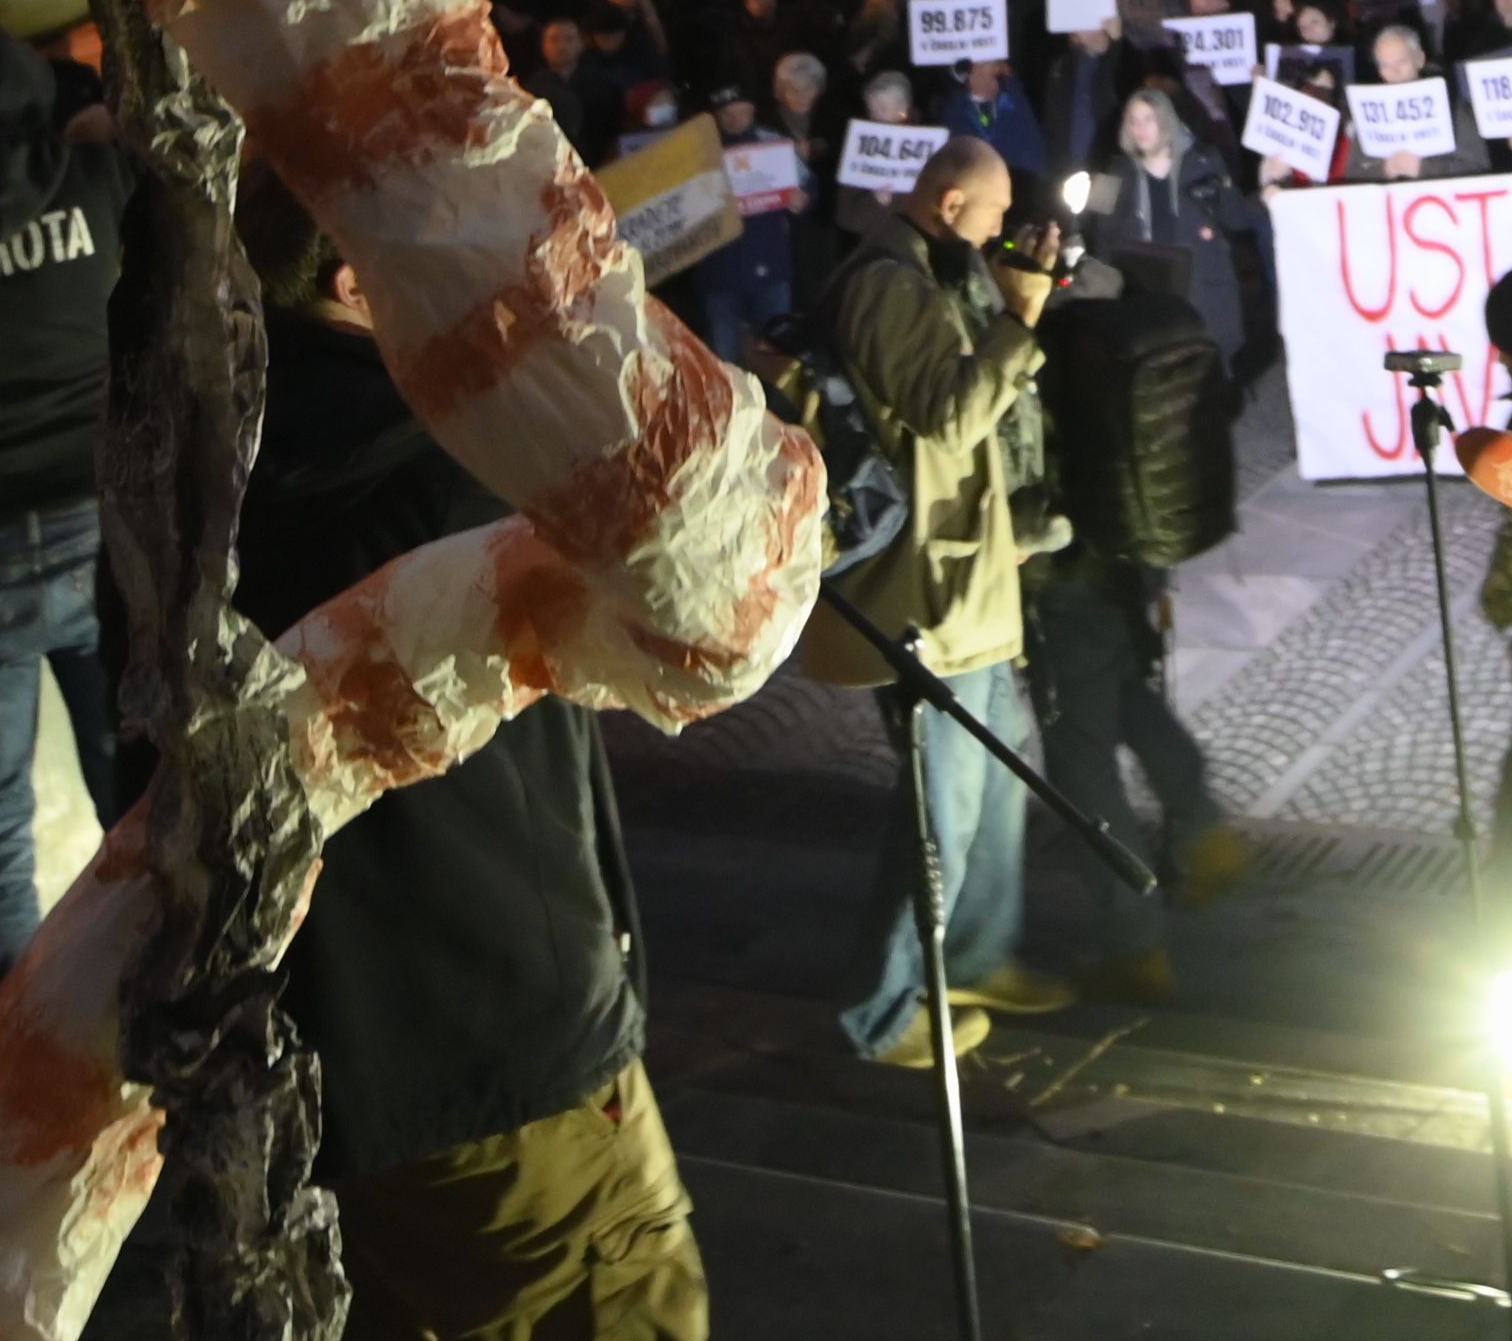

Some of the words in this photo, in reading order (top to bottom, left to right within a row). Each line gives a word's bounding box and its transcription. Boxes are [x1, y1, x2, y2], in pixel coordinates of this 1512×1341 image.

[920, 6, 993, 34] 99.875
[1264, 93, 1327, 141] 102.913
[1360, 96, 1435, 124] 131.452
